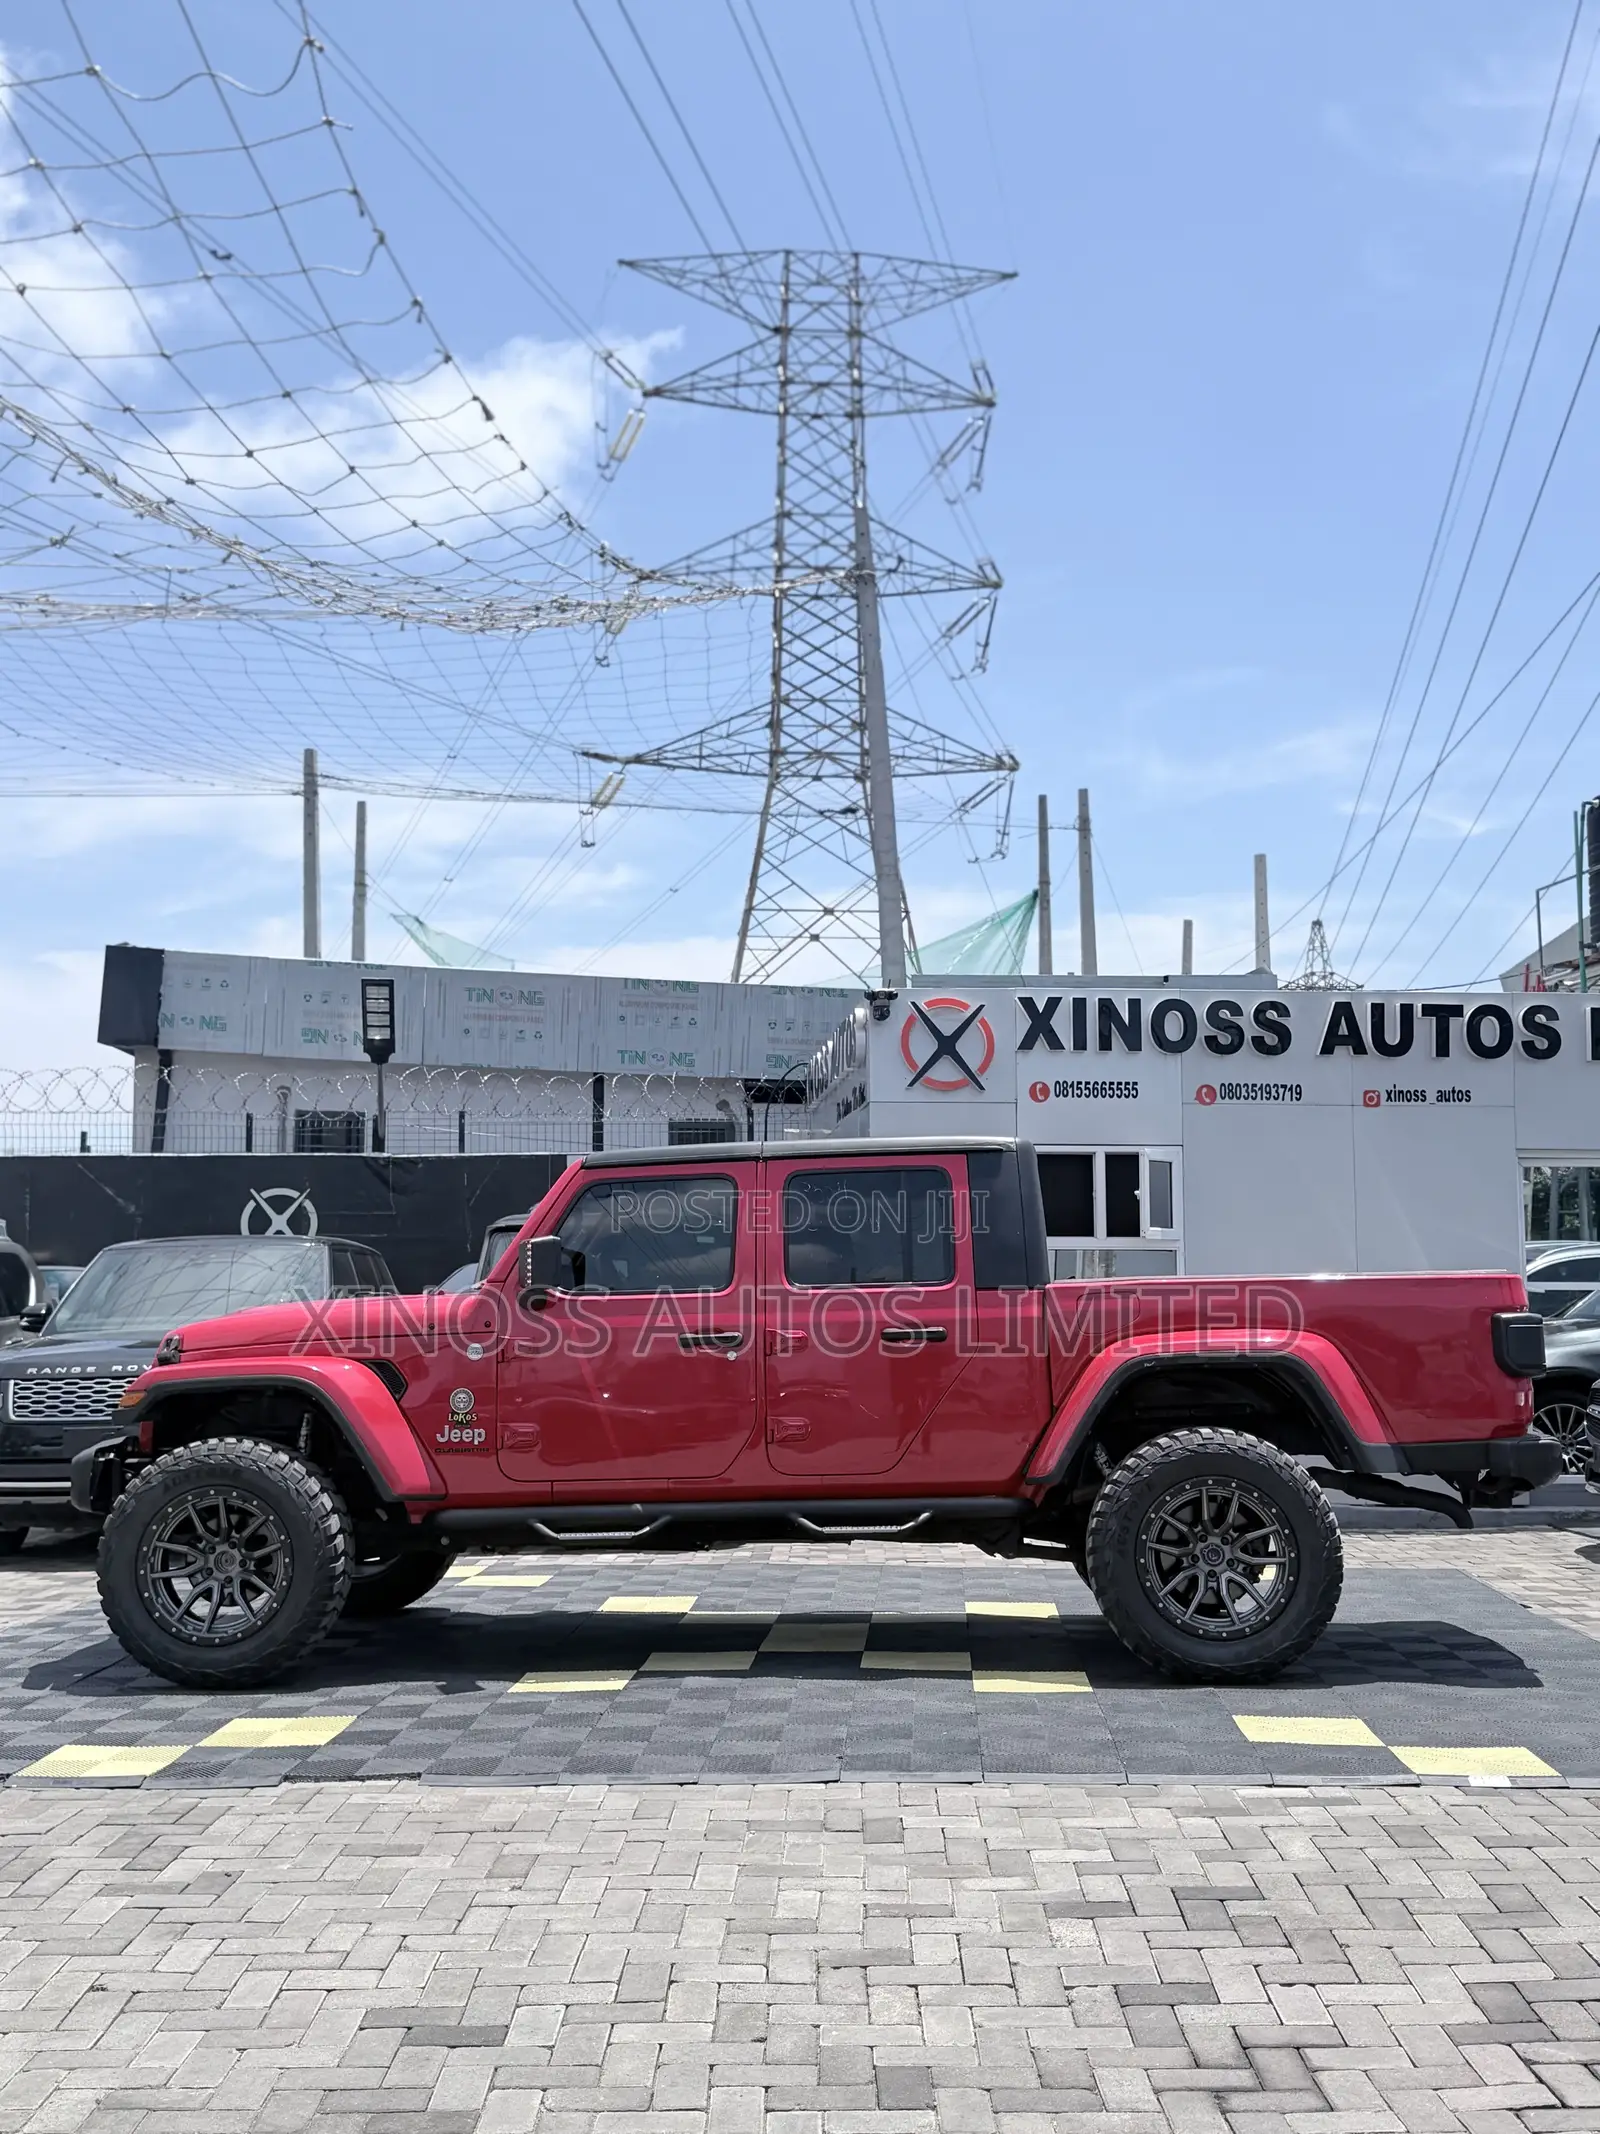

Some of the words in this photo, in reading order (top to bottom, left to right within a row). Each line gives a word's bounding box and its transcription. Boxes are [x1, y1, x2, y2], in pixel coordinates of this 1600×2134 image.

[1015, 995, 1292, 1056] XINOSS
[1316, 1000, 1562, 1061] AUTOS
[1053, 1080, 1139, 1099] 08155665555
[1219, 1082, 1303, 1102] 08035193719
[26, 1366, 97, 1375] RANGE
[111, 1364, 153, 1372] ROV
[436, 1425, 486, 1445] Jeep
